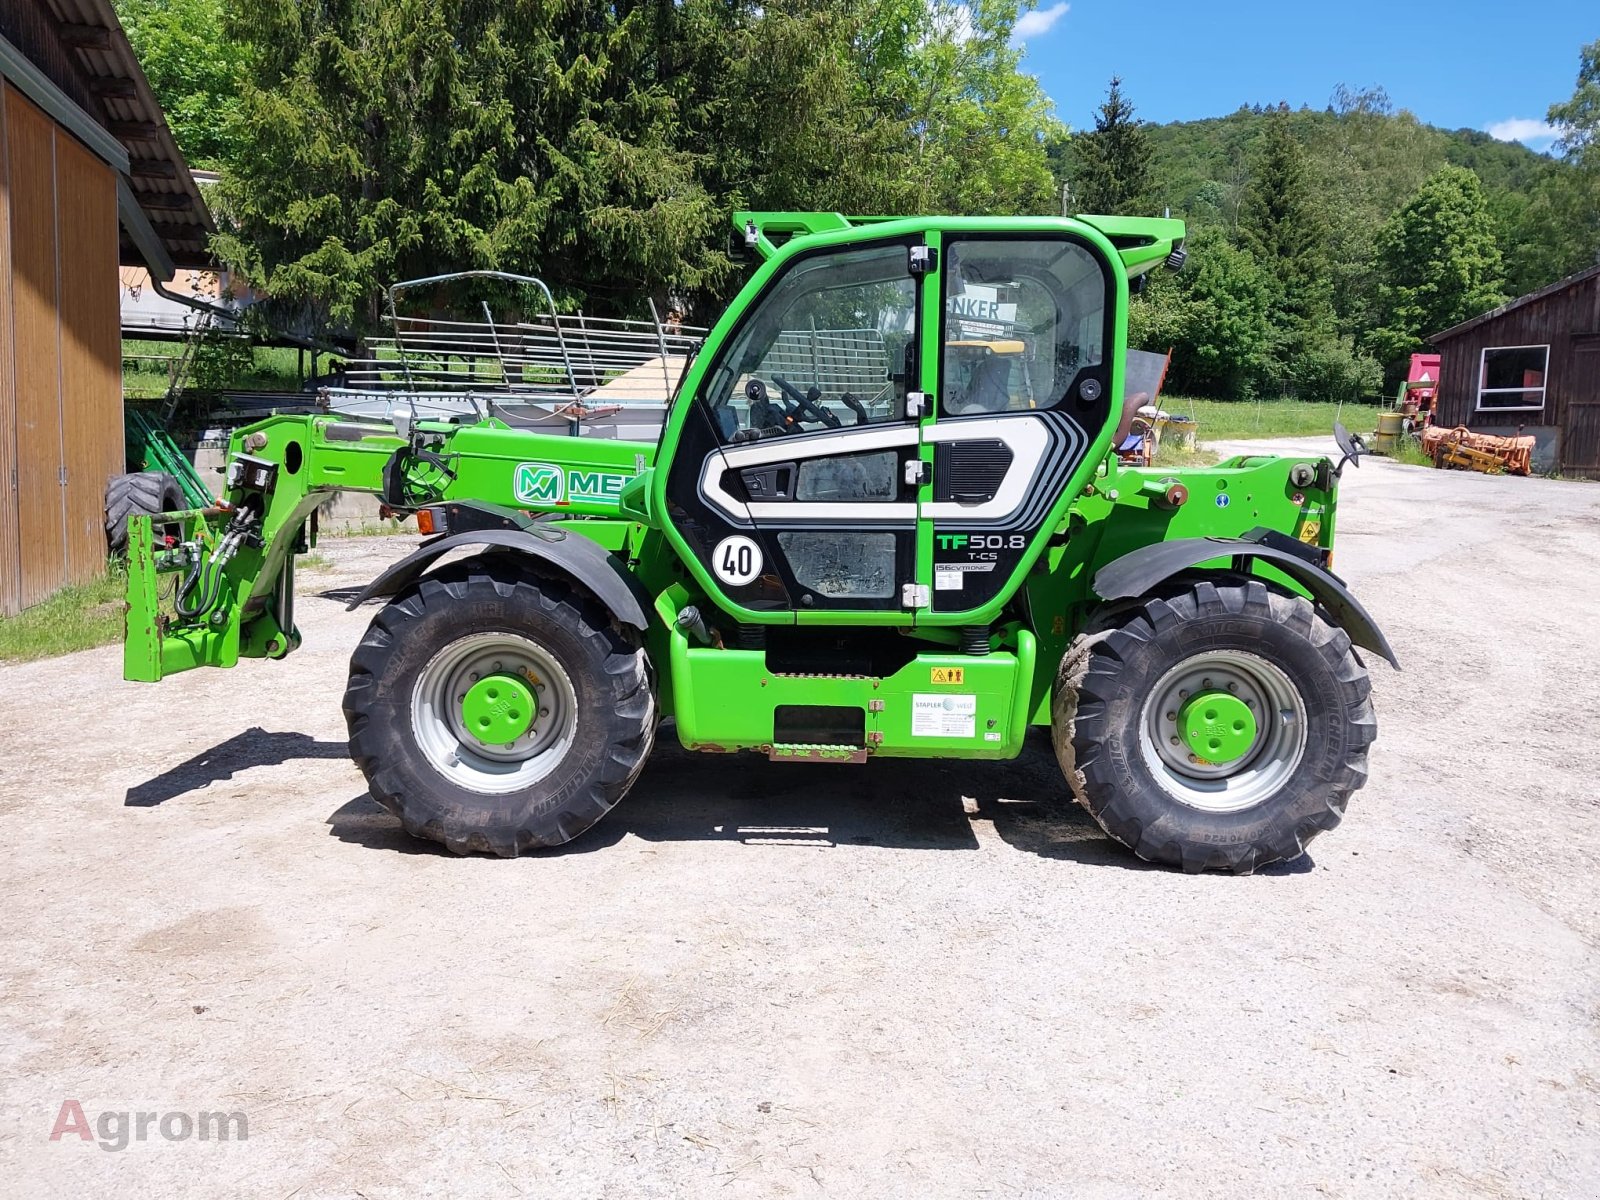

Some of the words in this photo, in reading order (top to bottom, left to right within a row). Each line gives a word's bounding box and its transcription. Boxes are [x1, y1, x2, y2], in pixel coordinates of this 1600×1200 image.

[936, 535, 1026, 550] TF50.8
[722, 544, 752, 576] 40
[968, 552, 998, 560] T-CS
[1317, 686, 1342, 782] MICHELIN
